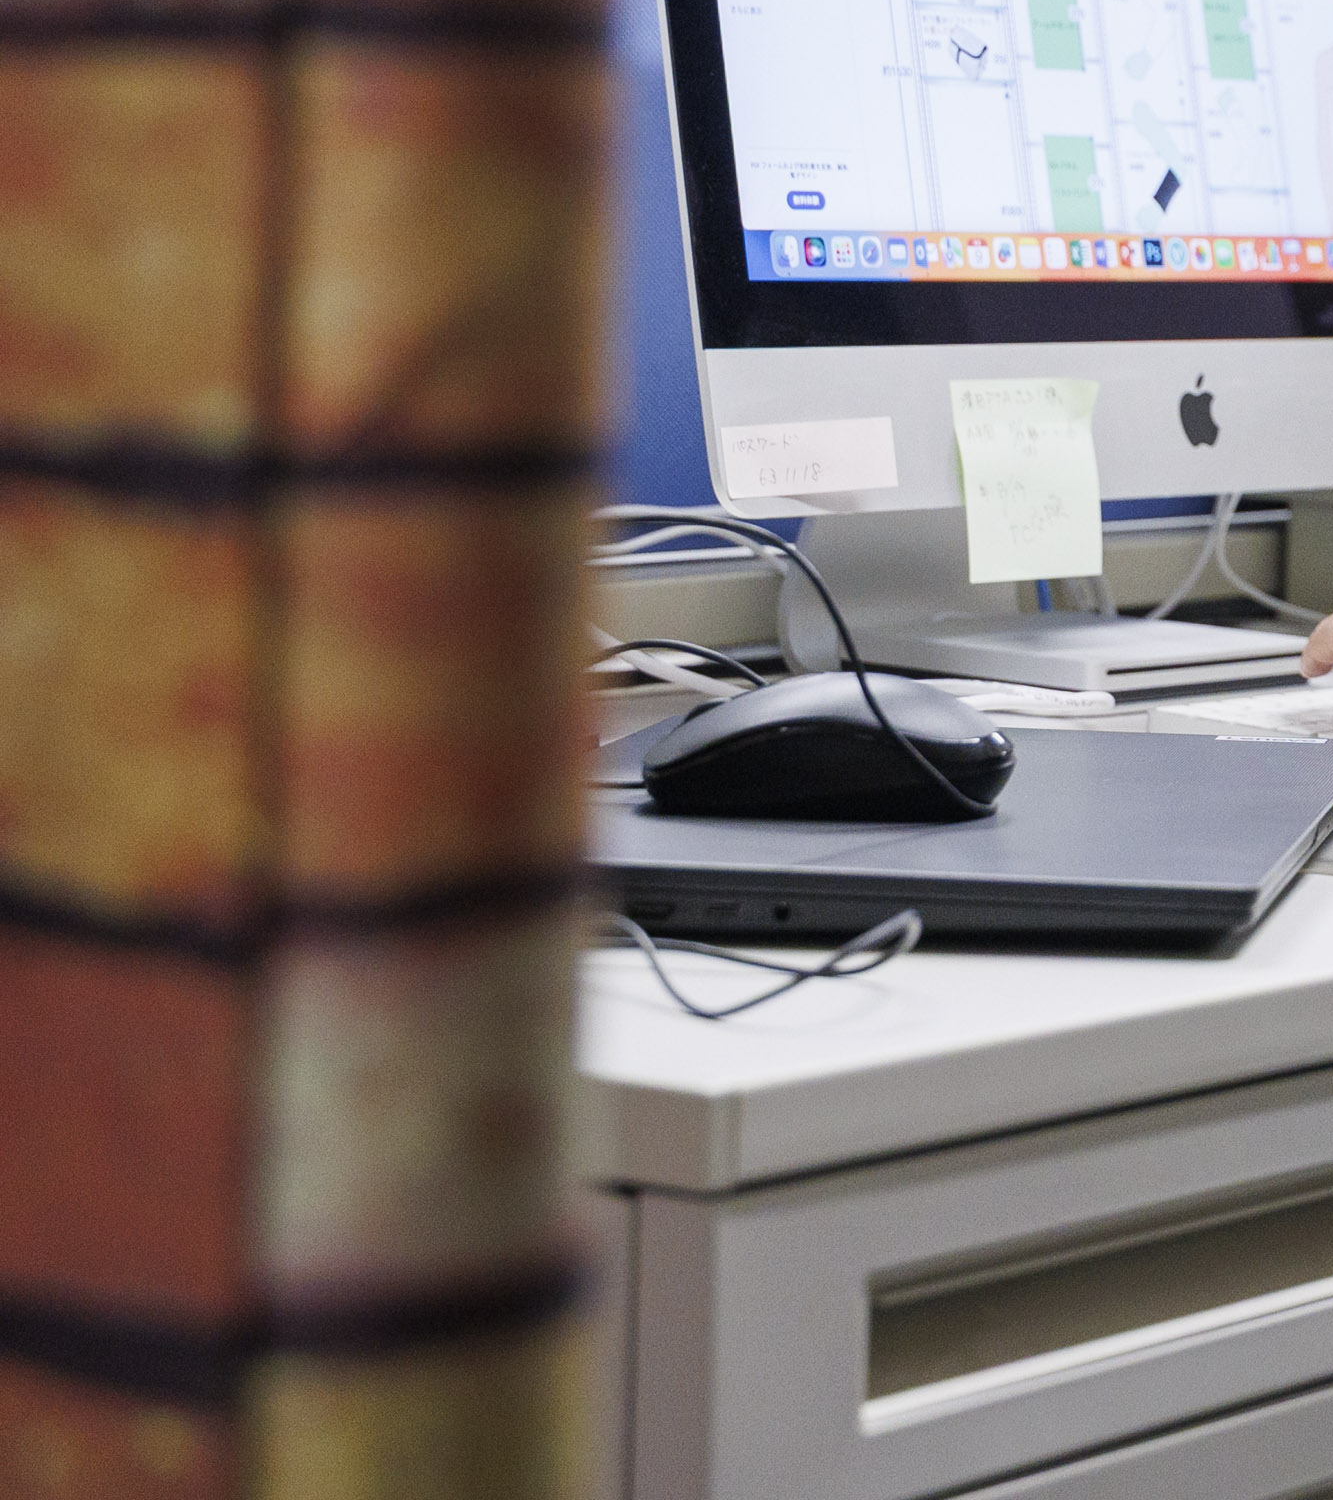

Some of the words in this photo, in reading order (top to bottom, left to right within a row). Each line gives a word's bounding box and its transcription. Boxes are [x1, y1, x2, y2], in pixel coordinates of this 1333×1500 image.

[732, 433, 799, 454] パスワード
